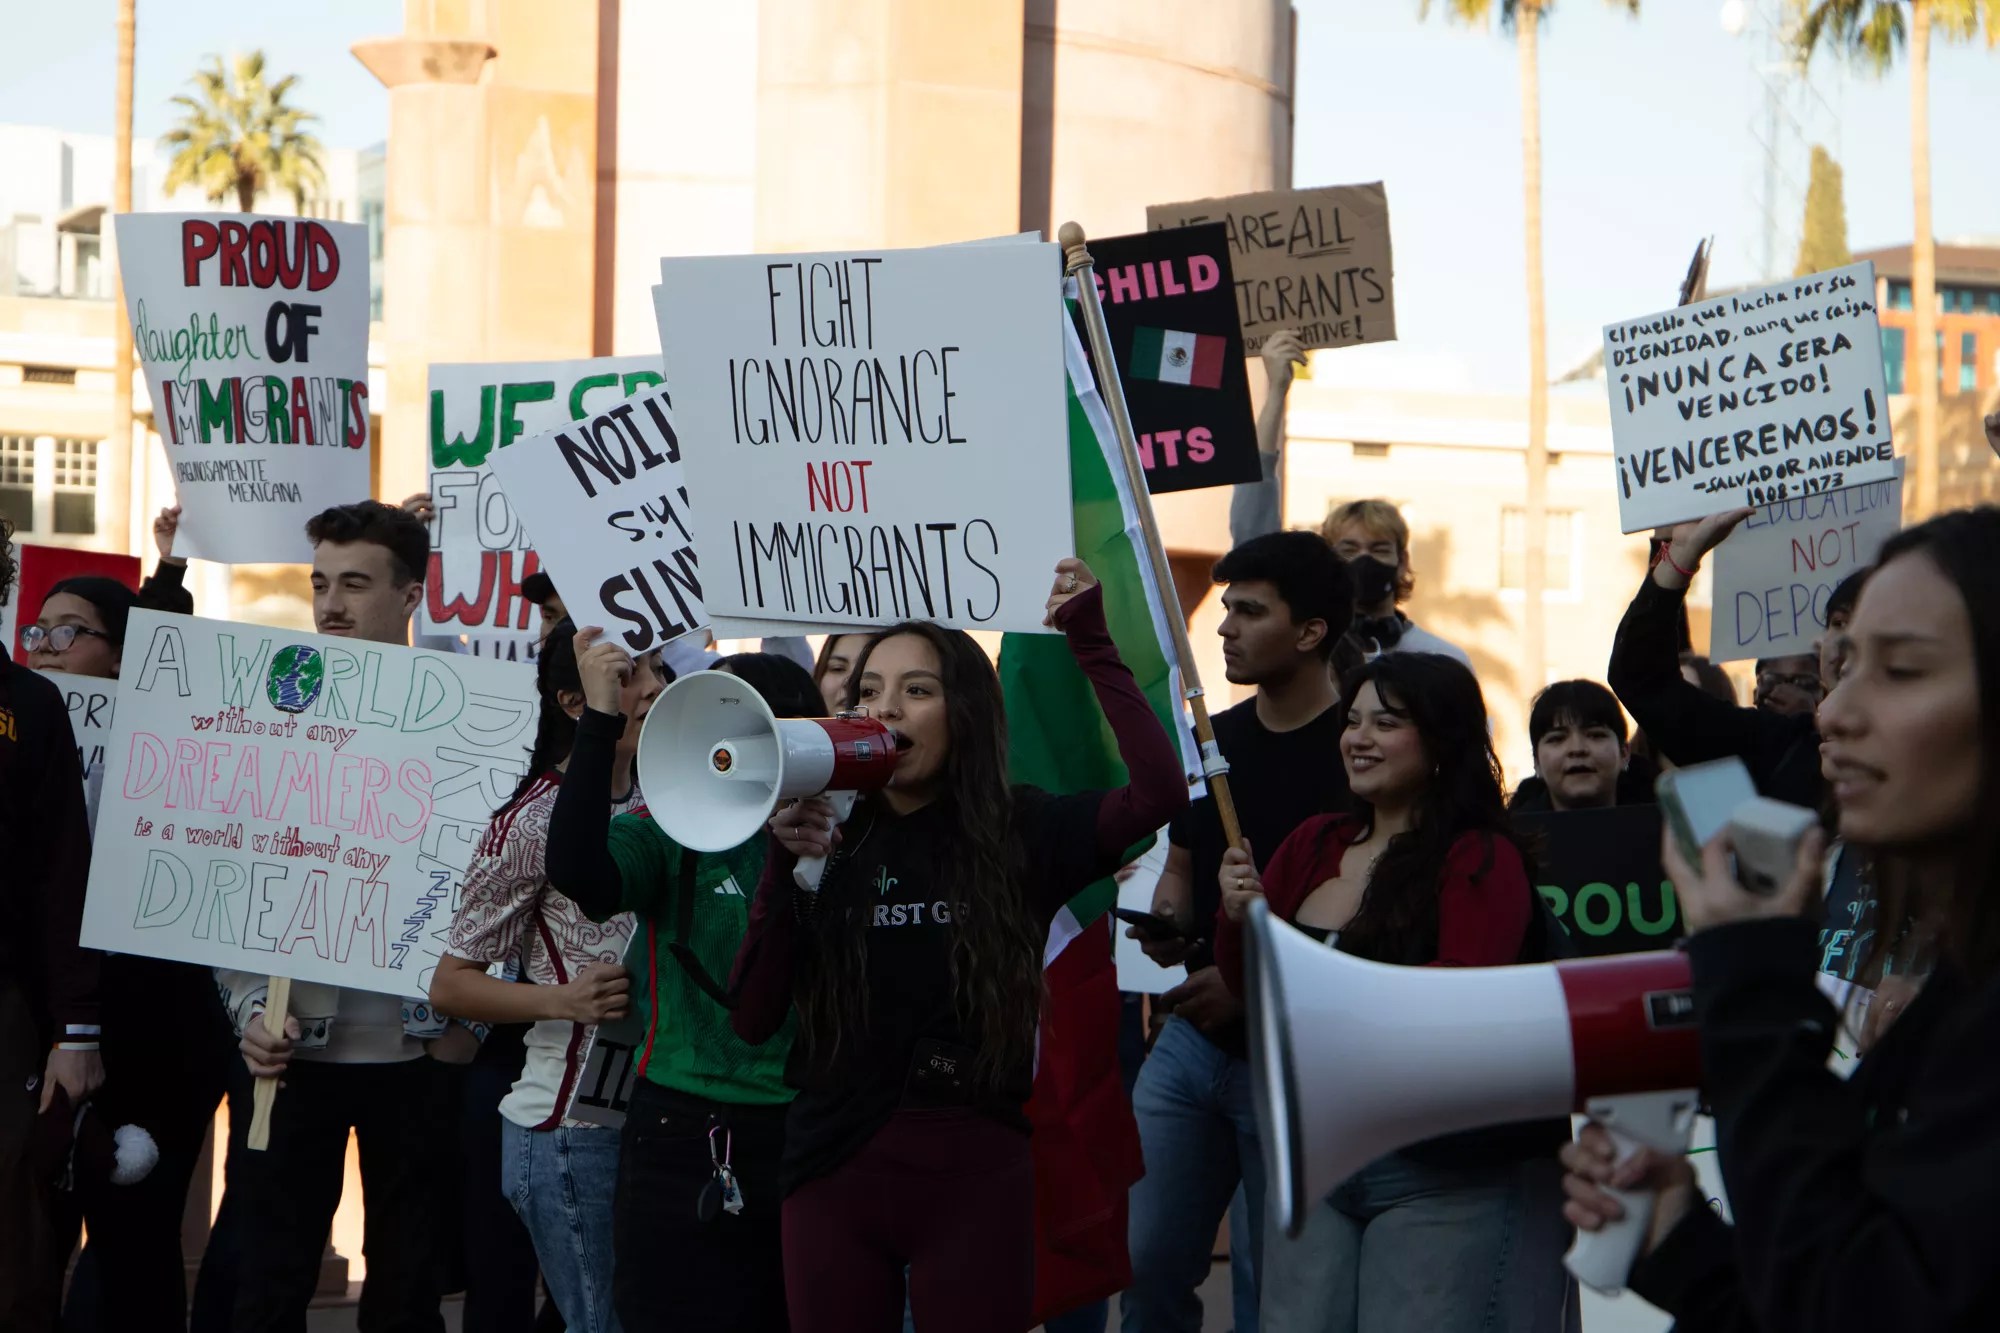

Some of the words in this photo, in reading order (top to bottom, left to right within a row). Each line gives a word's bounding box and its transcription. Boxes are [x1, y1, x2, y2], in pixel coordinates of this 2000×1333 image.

[182, 219, 341, 291] PROUD
[1226, 211, 1285, 256] ARE
[1287, 205, 1354, 255] ALL
[767, 258, 882, 350] FIGHT
[1613, 328, 1738, 367] DIGNIDAD,
[1743, 310, 1819, 336] aunque
[1630, 315, 1684, 340] pueblo
[1692, 305, 1725, 327] que
[1732, 292, 1788, 314] lucha
[135, 298, 261, 387] daughter
[265, 301, 322, 363] OF
[1777, 333, 1852, 368] SERA
[162, 376, 368, 450] IMMIGRANTS
[729, 346, 967, 446] IGNORANCE
[1678, 363, 1831, 421] VENCIDO!
[554, 391, 682, 499] TION
[1618, 388, 1876, 499] ¡VENCEREMOS!
[228, 482, 302, 503] MEXICANA
[429, 471, 535, 550] FO
[607, 485, 694, 543] his
[806, 460, 872, 514] NOT
[733, 518, 1001, 622] IMMIGRANTS
[1791, 521, 1861, 574] NOT
[425, 551, 543, 630] WH
[599, 546, 704, 651] NTS
[1736, 580, 1842, 646] DEPO
[136, 625, 191, 697] A
[191, 706, 297, 738] without
[306, 724, 357, 752] any
[123, 732, 433, 843] DREAMERS
[134, 816, 153, 836] is
[161, 823, 174, 840] a
[186, 823, 244, 849] world
[252, 825, 340, 863] without
[343, 847, 390, 884] any
[133, 849, 389, 968] DREAM
